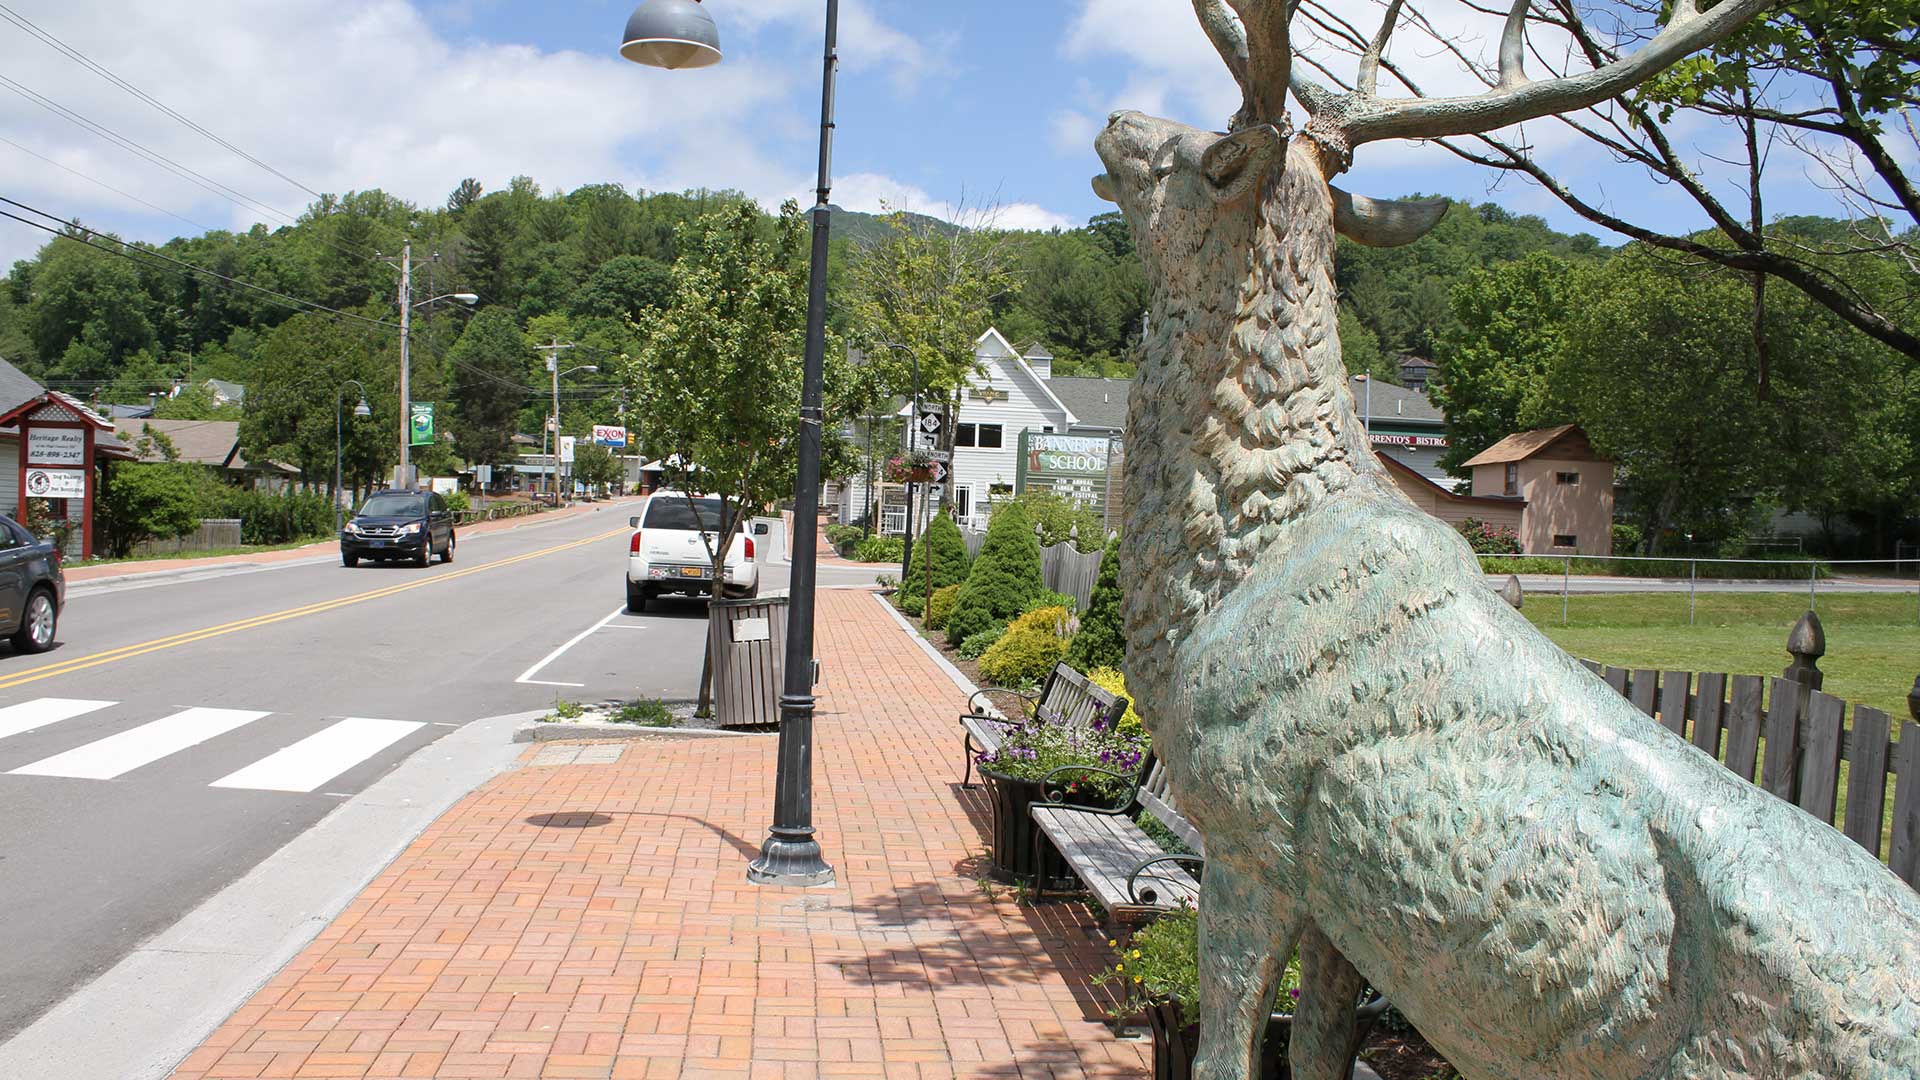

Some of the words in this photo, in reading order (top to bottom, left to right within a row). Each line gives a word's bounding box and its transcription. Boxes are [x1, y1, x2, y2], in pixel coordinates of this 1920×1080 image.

[923, 403, 942, 412] NORTH
[924, 418, 938, 427] 184
[29, 433, 60, 442] Heritage
[61, 434, 83, 444] Realty
[597, 429, 624, 439] EXXON
[1035, 435, 1091, 453] BANNER
[1095, 439, 1120, 454] ELK
[1367, 434, 1410, 444] RRENTO'S
[1416, 436, 1447, 446] BISTRO
[929, 450, 949, 459] NORTH
[1049, 455, 1105, 471] SCHOOL
